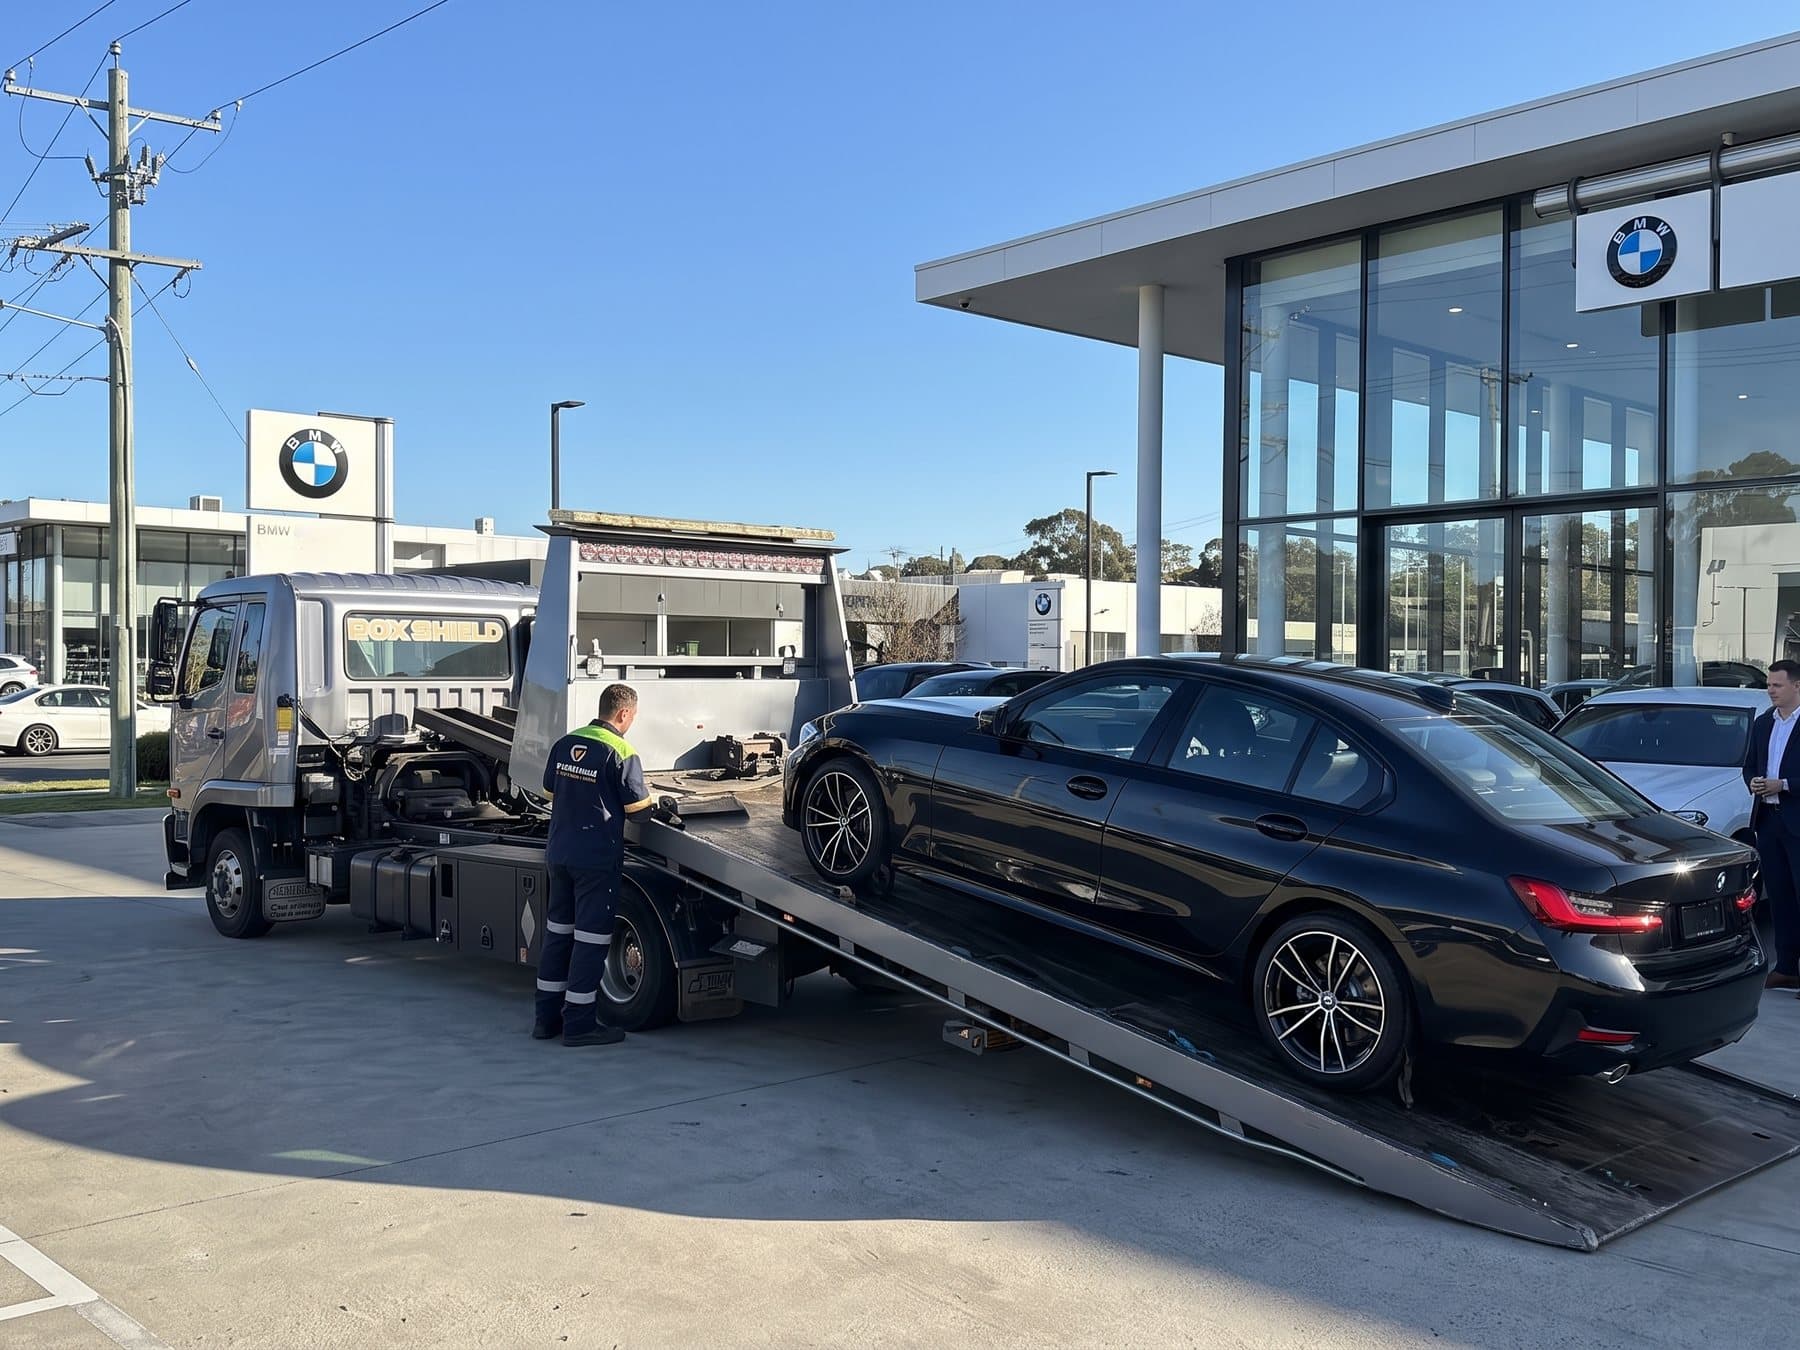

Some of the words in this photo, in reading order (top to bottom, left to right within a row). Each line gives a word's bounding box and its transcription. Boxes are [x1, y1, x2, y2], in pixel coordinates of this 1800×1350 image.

[1613, 218, 1671, 244] BMW
[286, 430, 344, 454] BMW
[257, 524, 291, 536] BMW
